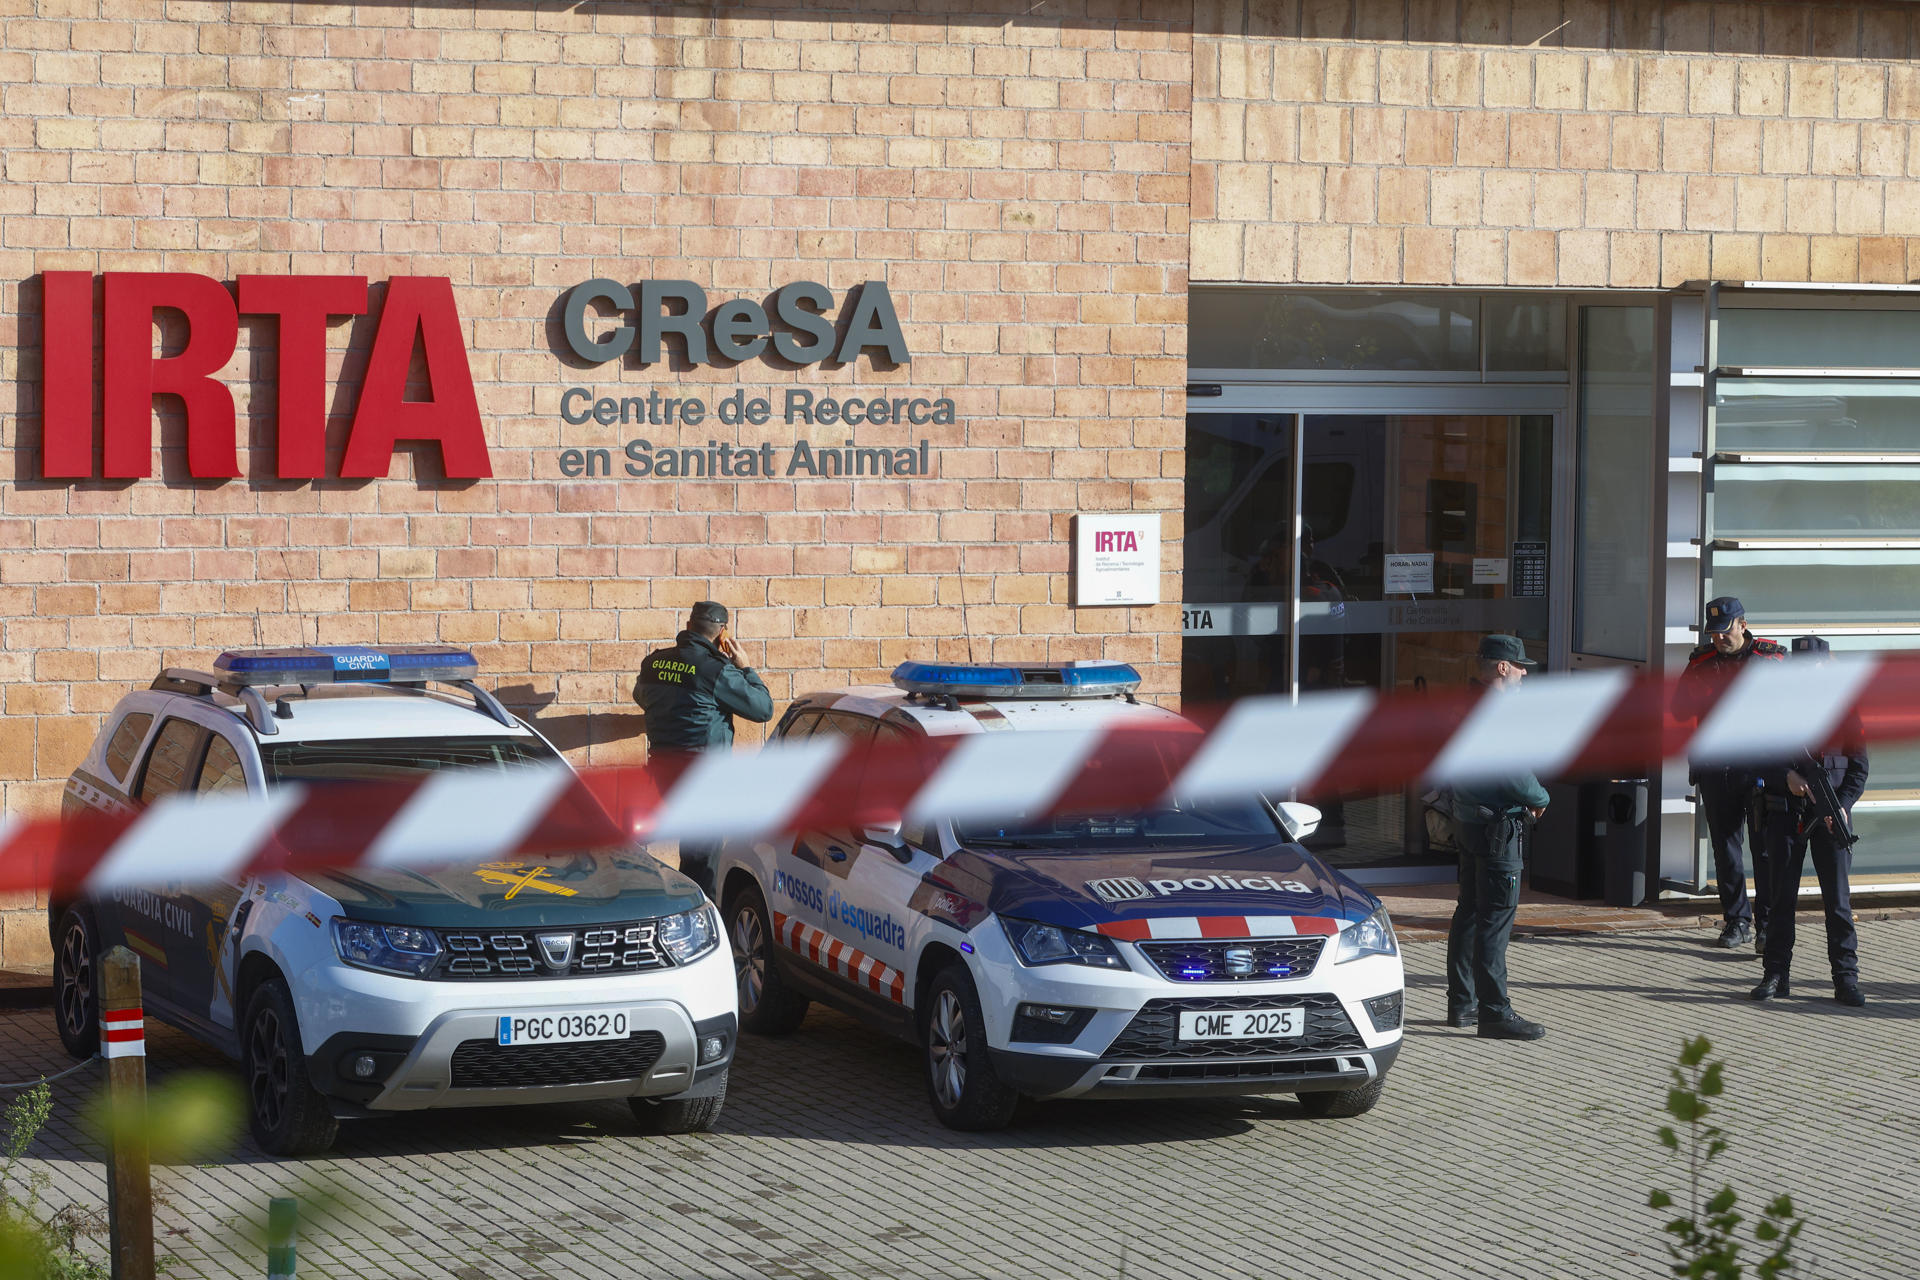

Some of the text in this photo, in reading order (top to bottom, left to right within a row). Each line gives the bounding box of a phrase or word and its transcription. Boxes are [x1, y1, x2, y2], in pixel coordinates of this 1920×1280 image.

[563, 277, 911, 365] CReSA
[41, 270, 494, 479] IRTA
[560, 387, 956, 426] Centre de Recerca
[559, 439, 930, 477] en Sanitat Animal
[1095, 530, 1138, 553] IRTA
[336, 653, 385, 664] GUARDIA
[349, 661, 376, 670] CIVIL
[652, 660, 697, 675] GUARDIA
[658, 671, 682, 684] CIVIL
[1148, 874, 1314, 896] policia
[113, 882, 194, 939] GUARDIA CIVIL
[772, 869, 905, 951] mossos d'esquadra
[513, 1017, 553, 1041] PGC
[1195, 1012, 1292, 1036] CME 2025
